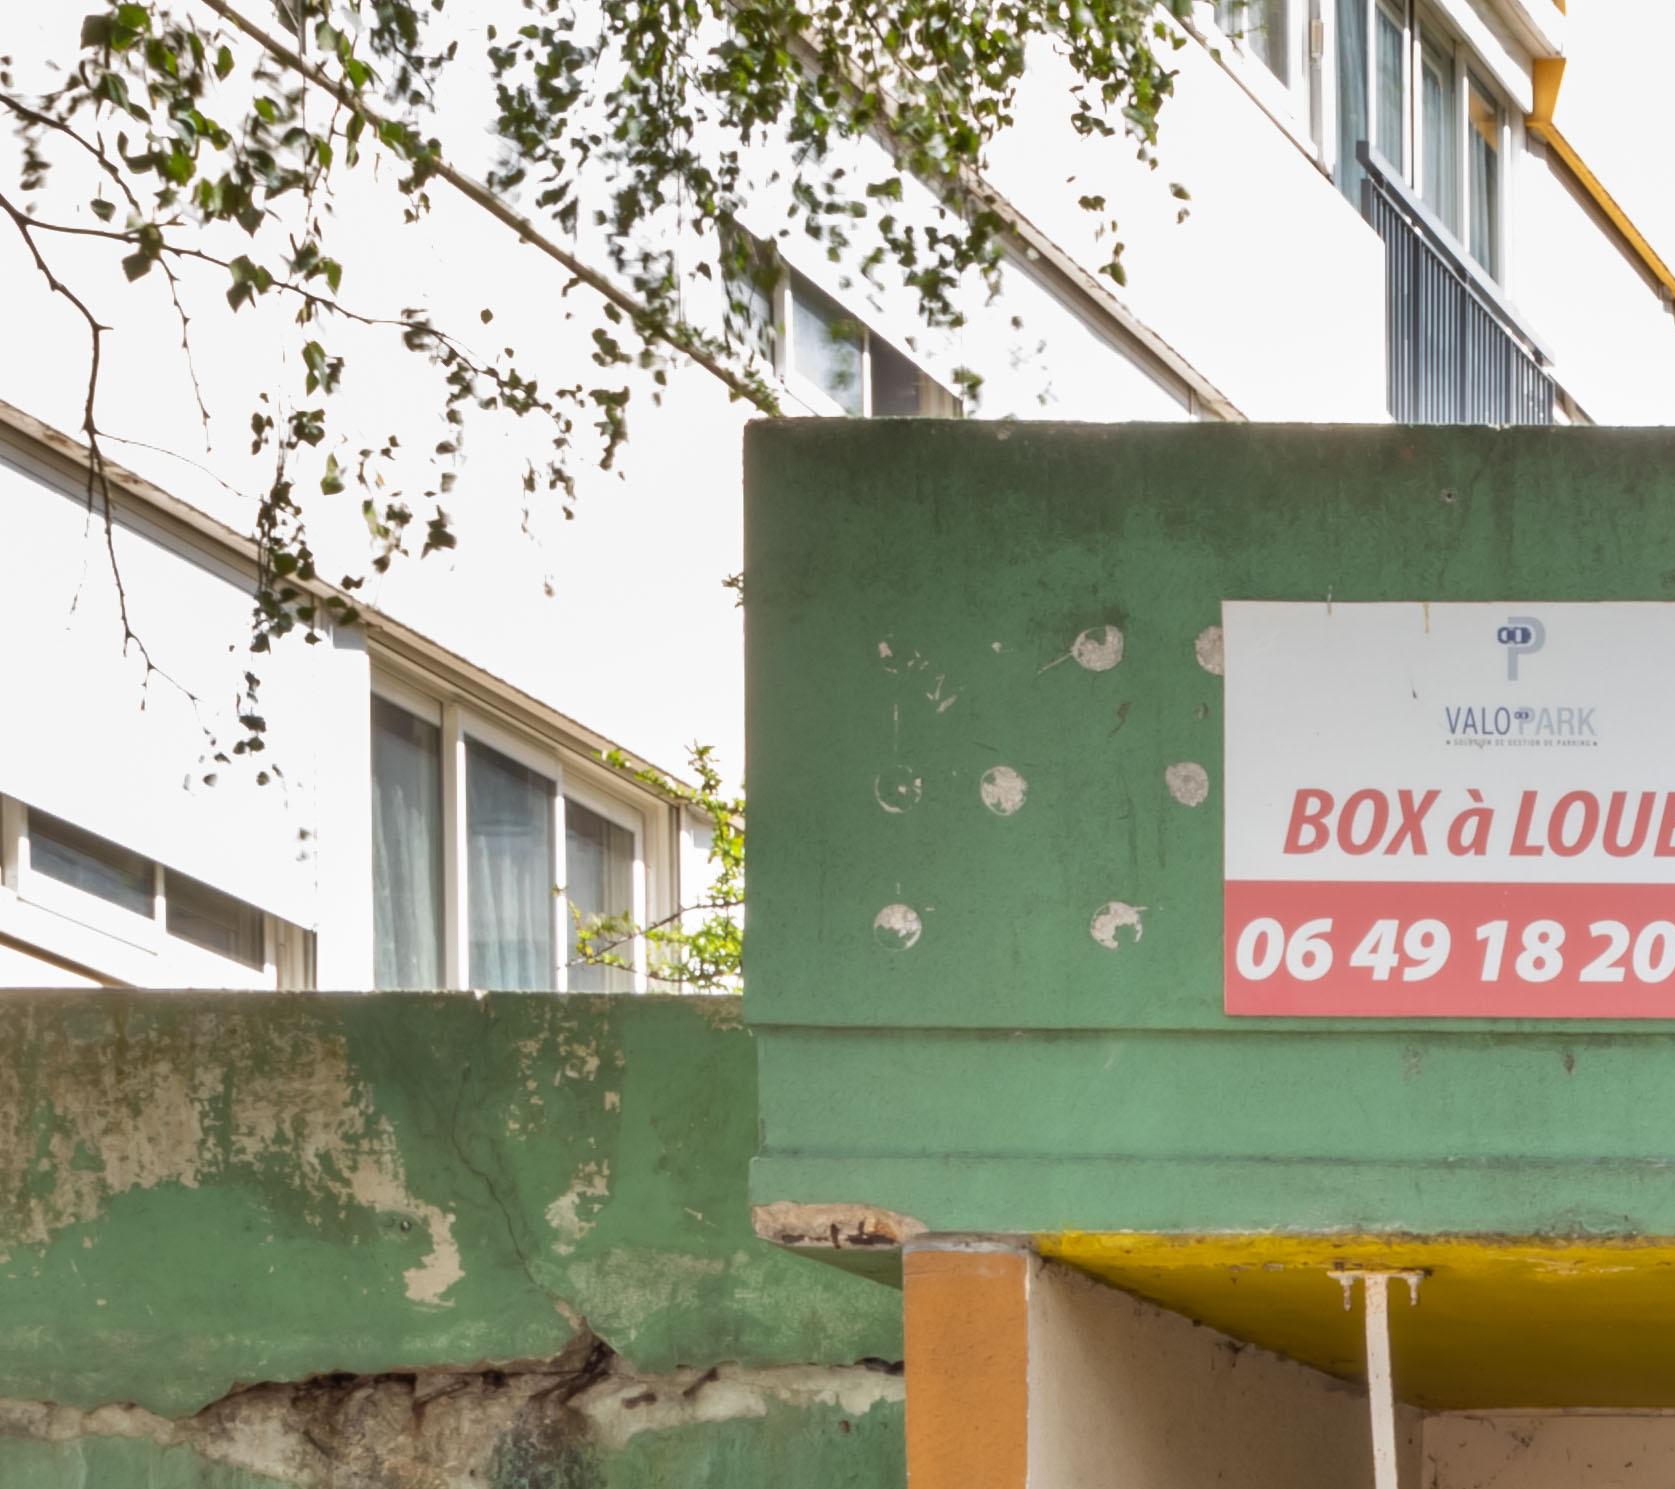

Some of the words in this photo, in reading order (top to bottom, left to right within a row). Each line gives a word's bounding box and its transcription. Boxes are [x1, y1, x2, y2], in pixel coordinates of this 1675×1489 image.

[1283, 787, 1441, 857] BOX
[1446, 787, 1495, 857] à
[1235, 917, 1334, 982] 06
[1349, 918, 1451, 982] 49
[1475, 919, 1566, 983] 18
